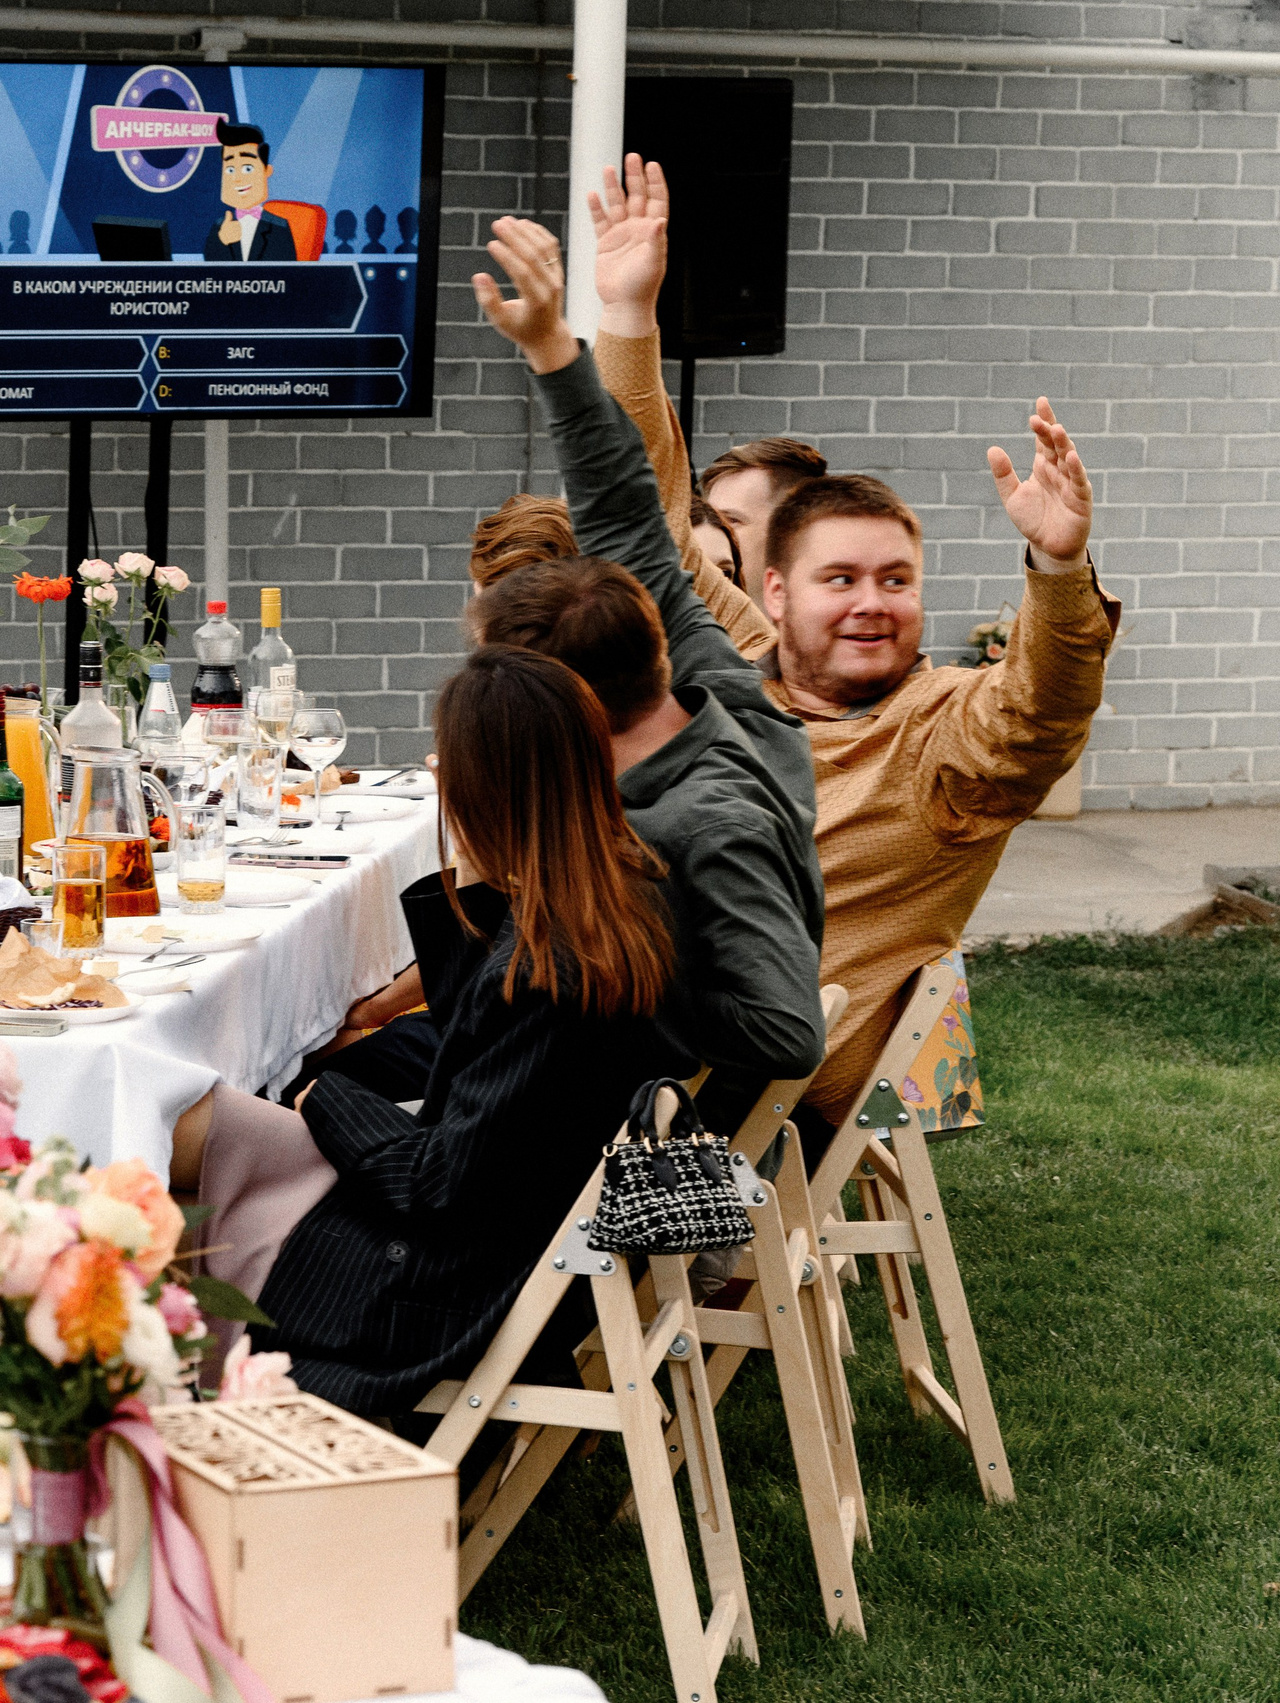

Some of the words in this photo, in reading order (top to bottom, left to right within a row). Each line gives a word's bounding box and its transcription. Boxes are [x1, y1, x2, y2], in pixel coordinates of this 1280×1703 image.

[104, 120, 215, 139] АНЧЕРБАК-ШОУ
[12, 280, 23, 294] В
[25, 280, 77, 294] КАКОМ
[79, 280, 173, 296] УЧРЕЖДЕНИИ
[175, 277, 223, 294] СЕМЁН
[225, 280, 286, 294] РАБОТАЛ
[109, 301, 190, 316] ЮРИСТОМ?
[158, 346, 171, 359] B:
[227, 347, 255, 359] ЗАГС
[158, 385, 172, 397] D:
[208, 381, 291, 396] ПЕНСИОННЫЙ
[293, 383, 330, 397] ФОНД
